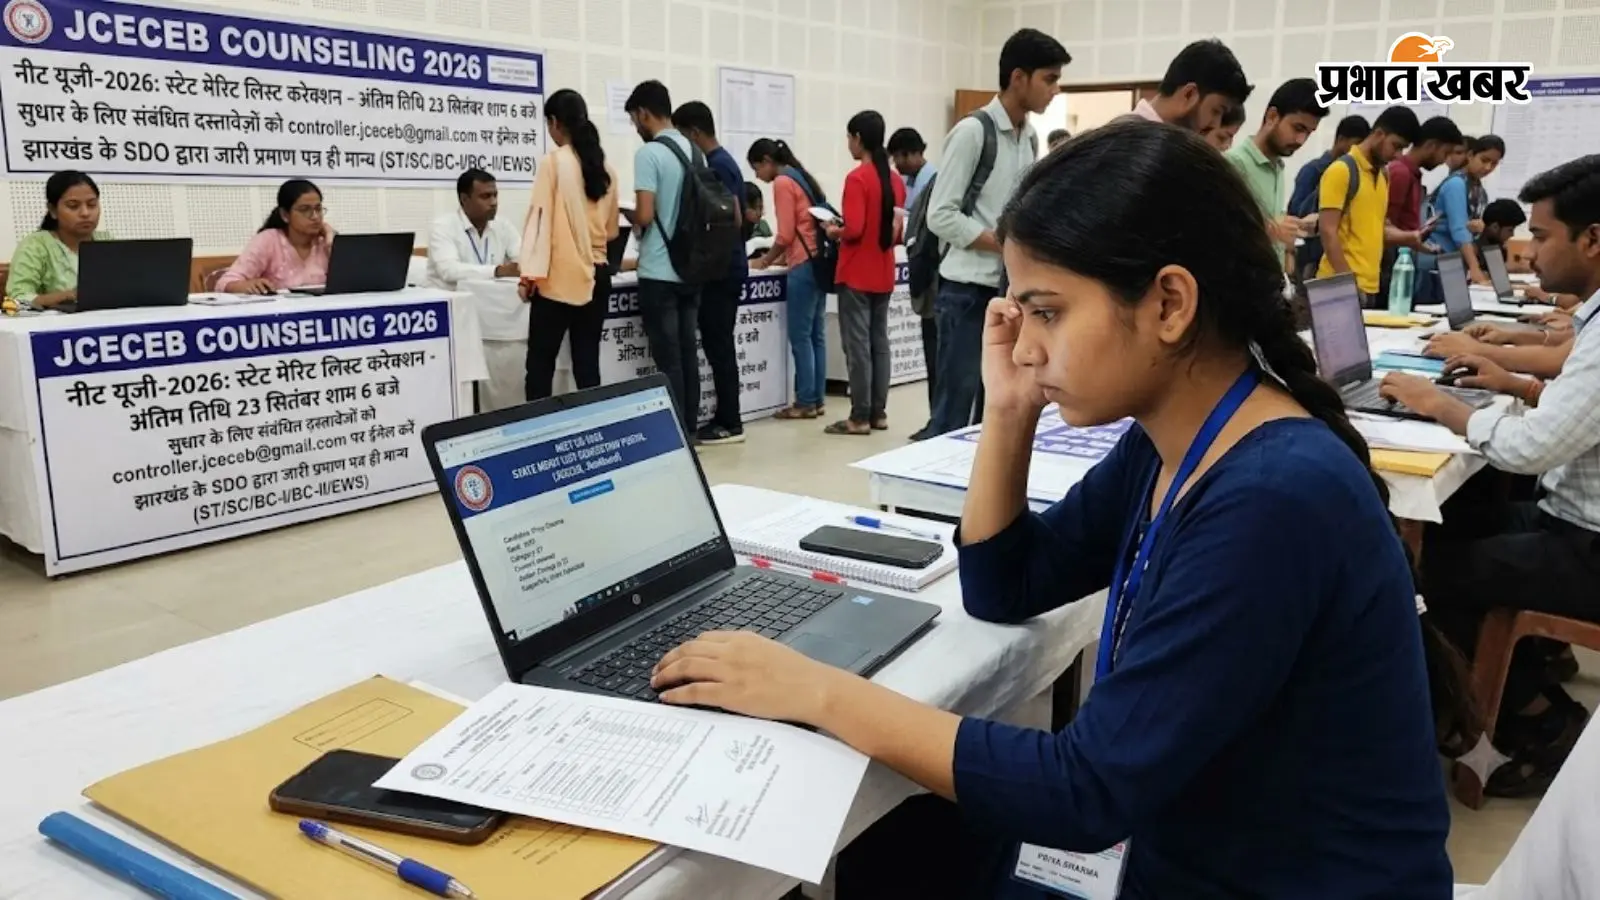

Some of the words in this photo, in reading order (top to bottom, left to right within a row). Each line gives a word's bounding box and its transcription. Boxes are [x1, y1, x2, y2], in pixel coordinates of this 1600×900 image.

[64, 10, 210, 52] JCECEB
[220, 26, 416, 74] COUNSELING
[423, 50, 482, 80] 2026
[13, 57, 49, 84] नीट
[53, 62, 160, 93] यूजी-2026:
[165, 70, 198, 96] स्टेट
[203, 73, 240, 99] मेरिट
[244, 76, 283, 101] लिस्ट
[359, 87, 394, 110] अंतिम
[428, 97, 444, 113] 23
[511, 104, 518, 118] 6
[17, 103, 65, 127] सुधार
[70, 99, 89, 123] के
[93, 101, 127, 126] लिए
[132, 104, 189, 128] संबंधित
[264, 111, 284, 133] को
[288, 120, 477, 144] controller.jceceb@gmail.com
[480, 130, 494, 144] पर
[22, 136, 93, 162] झारखंड
[98, 136, 118, 161] के
[124, 142, 170, 163] SDO
[174, 145, 208, 166] द्वारा
[213, 141, 249, 165] जारी
[253, 147, 297, 166] प्रमाण
[301, 150, 322, 167] पत्र
[325, 144, 341, 169] ही
[344, 150, 375, 168] मान्य
[607, 292, 639, 313] ECE
[750, 280, 781, 299] 2026
[53, 330, 187, 367] JCECEB
[196, 315, 376, 354] COUNSELING
[383, 309, 438, 337] 2026
[66, 381, 106, 407] नीट
[112, 372, 230, 408] यूजी-2026:
[235, 363, 272, 387] स्टेट
[276, 359, 317, 382] मेरिट
[322, 355, 363, 378] लिस्ट
[130, 405, 184, 431] अंतिम
[189, 398, 231, 424] तिथि
[236, 398, 261, 416] 23
[266, 388, 320, 413] सितंबर
[326, 385, 357, 403] शाम
[361, 383, 371, 399] 6
[376, 375, 400, 397] बजे
[168, 434, 206, 455] सुधार
[210, 428, 223, 444] के
[228, 425, 254, 443] लिए
[360, 405, 376, 421] को
[112, 436, 346, 484] controller.jceceb@gmail.com
[350, 431, 365, 443] पर
[134, 485, 189, 510] झारखंड
[192, 480, 207, 497] के
[211, 475, 248, 494] SDO
[281, 461, 309, 481] जारी
[369, 448, 381, 468] ही
